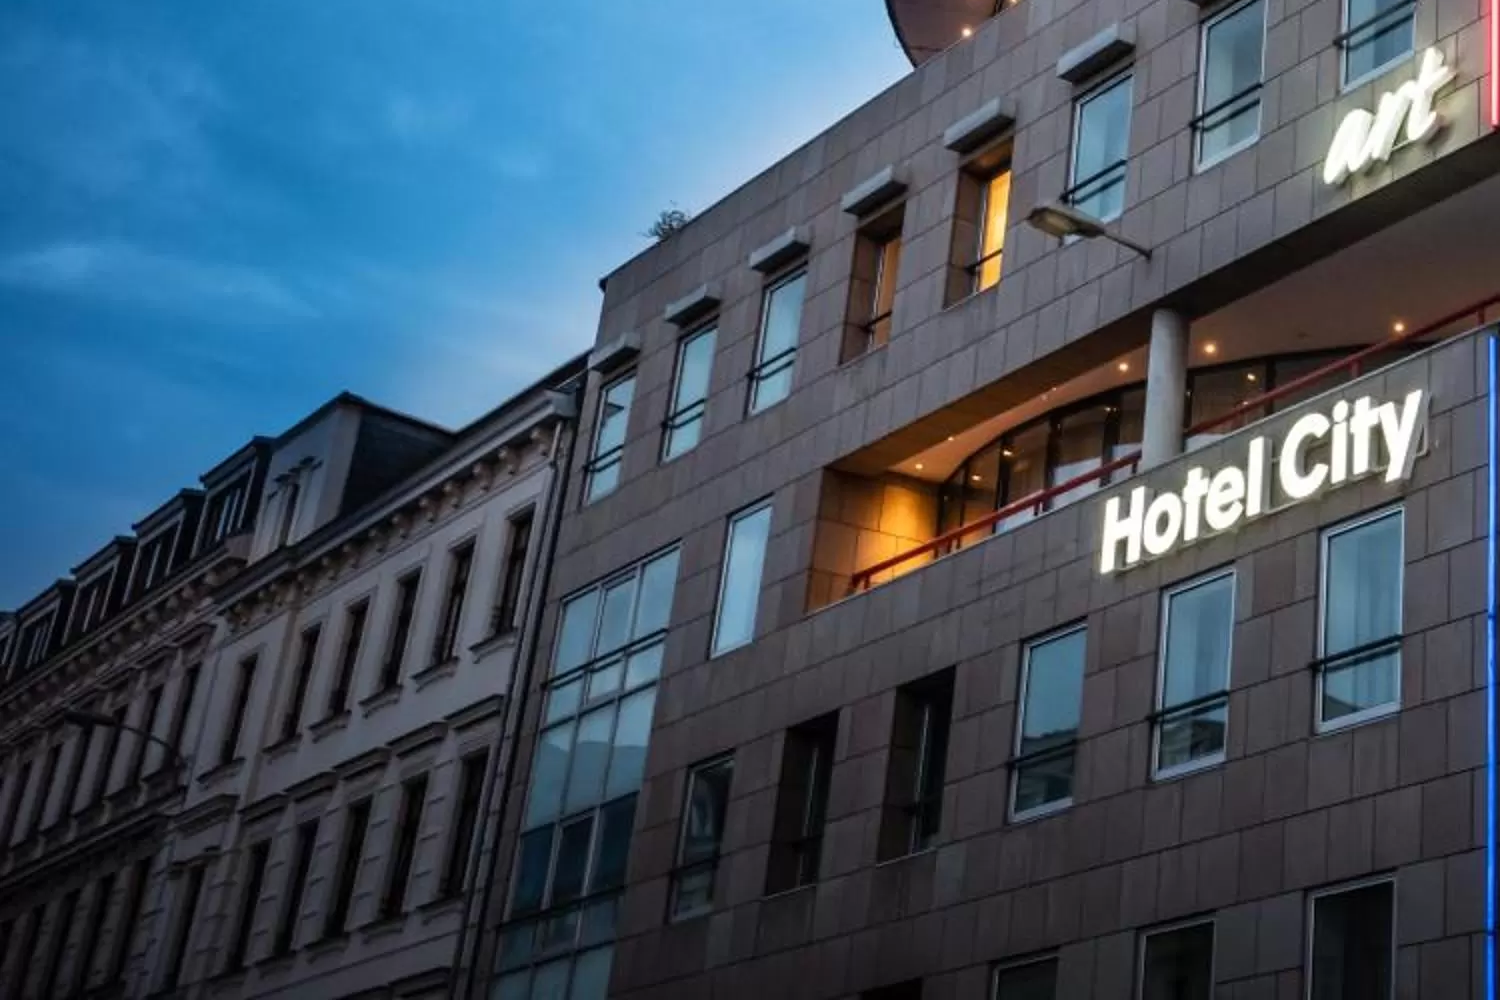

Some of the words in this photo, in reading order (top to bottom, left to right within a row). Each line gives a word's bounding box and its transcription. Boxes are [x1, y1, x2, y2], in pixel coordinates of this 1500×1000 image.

[1323, 47, 1455, 186] art
[1100, 437, 1265, 575] Hotel
[1280, 388, 1424, 500] City
